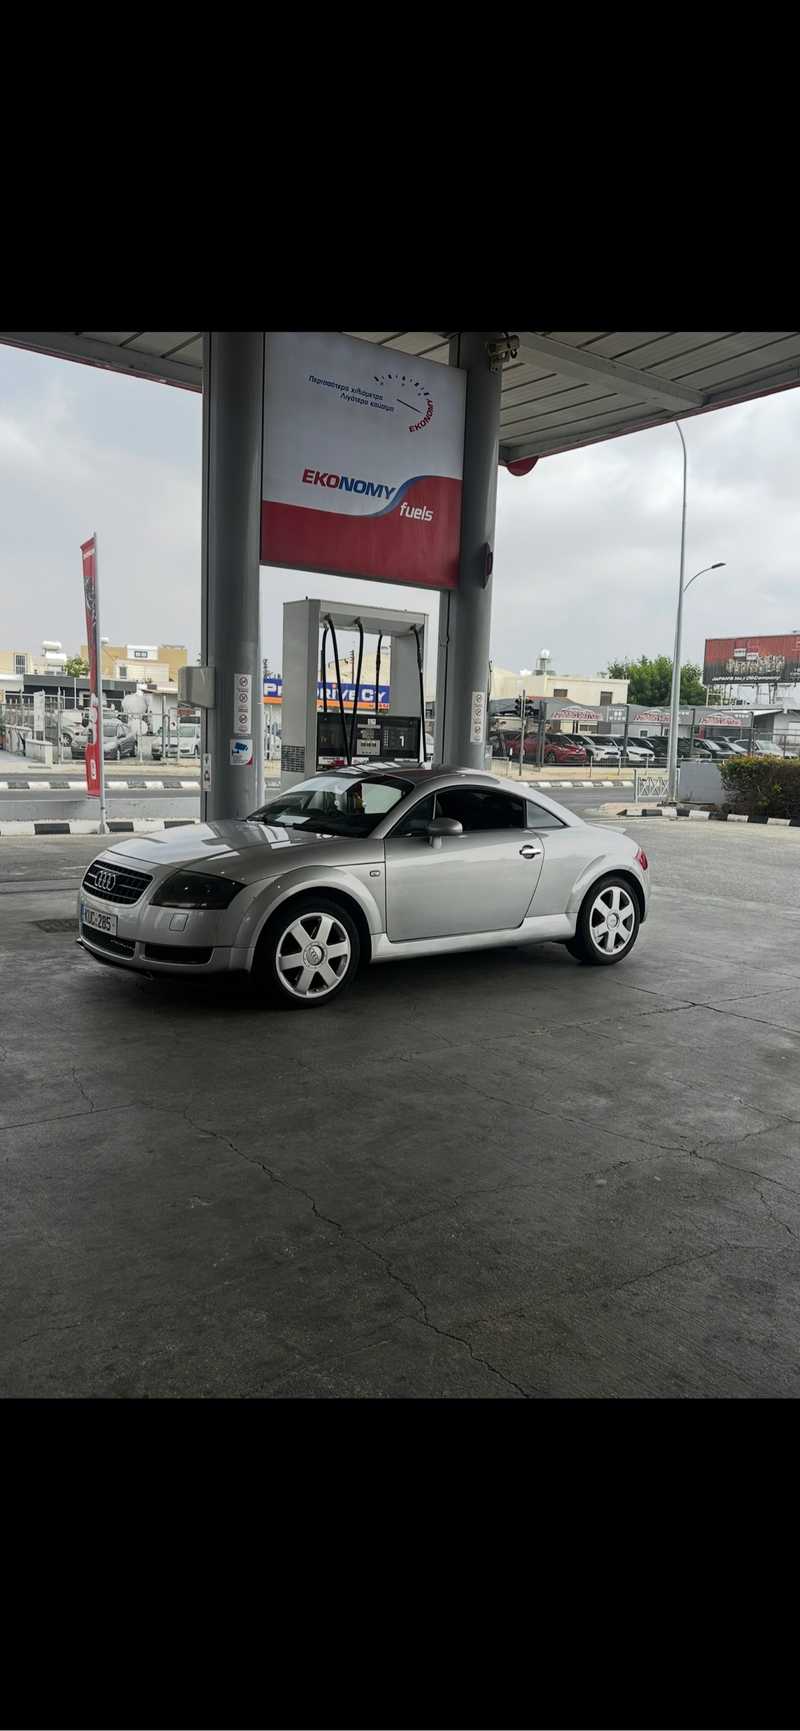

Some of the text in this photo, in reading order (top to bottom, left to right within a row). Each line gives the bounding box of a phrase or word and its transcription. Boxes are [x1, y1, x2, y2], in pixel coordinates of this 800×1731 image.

[408, 399, 434, 433] EKONOMY
[302, 468, 397, 500] EKONOMY
[399, 501, 434, 522] fuels
